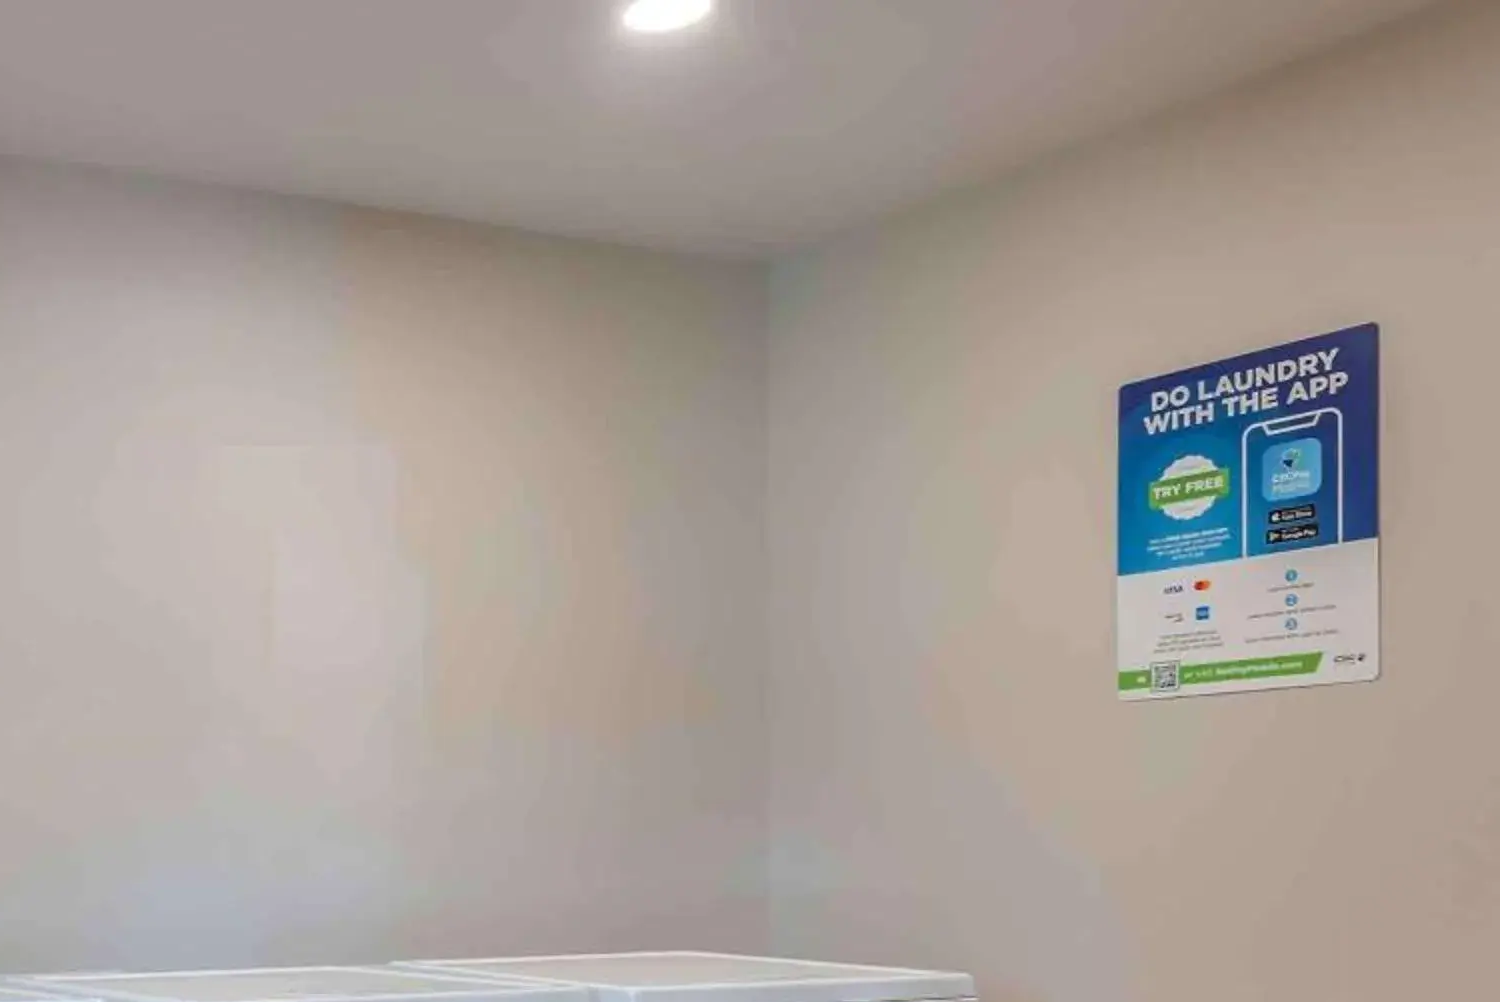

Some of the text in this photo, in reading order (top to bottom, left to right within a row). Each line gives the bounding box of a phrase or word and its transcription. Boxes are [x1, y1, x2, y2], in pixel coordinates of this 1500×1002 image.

[1143, 371, 1349, 436] WITH THE APP
[1151, 347, 1340, 412] DO LAUNDRY
[1153, 475, 1224, 500] TRY FREE
